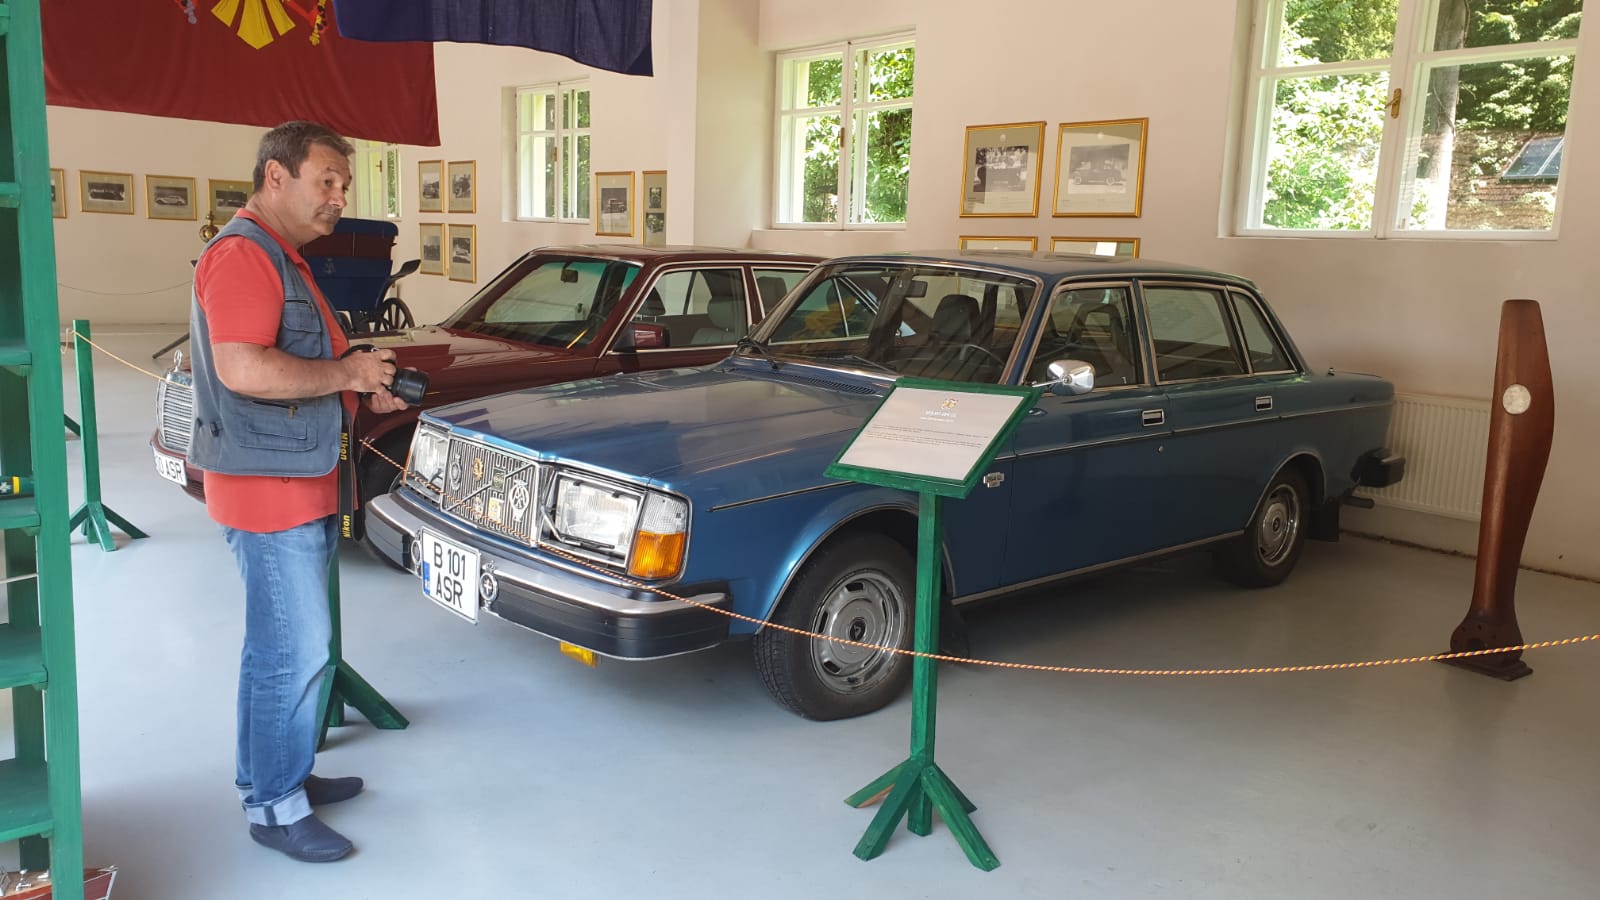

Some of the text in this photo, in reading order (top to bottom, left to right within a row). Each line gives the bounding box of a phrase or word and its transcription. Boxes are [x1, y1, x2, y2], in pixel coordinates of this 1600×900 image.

[340, 432, 348, 461] Nikon
[165, 459, 183, 482] ASR
[341, 514, 351, 538] Nikon
[433, 541, 466, 581] B 101
[435, 571, 463, 609] ASR
